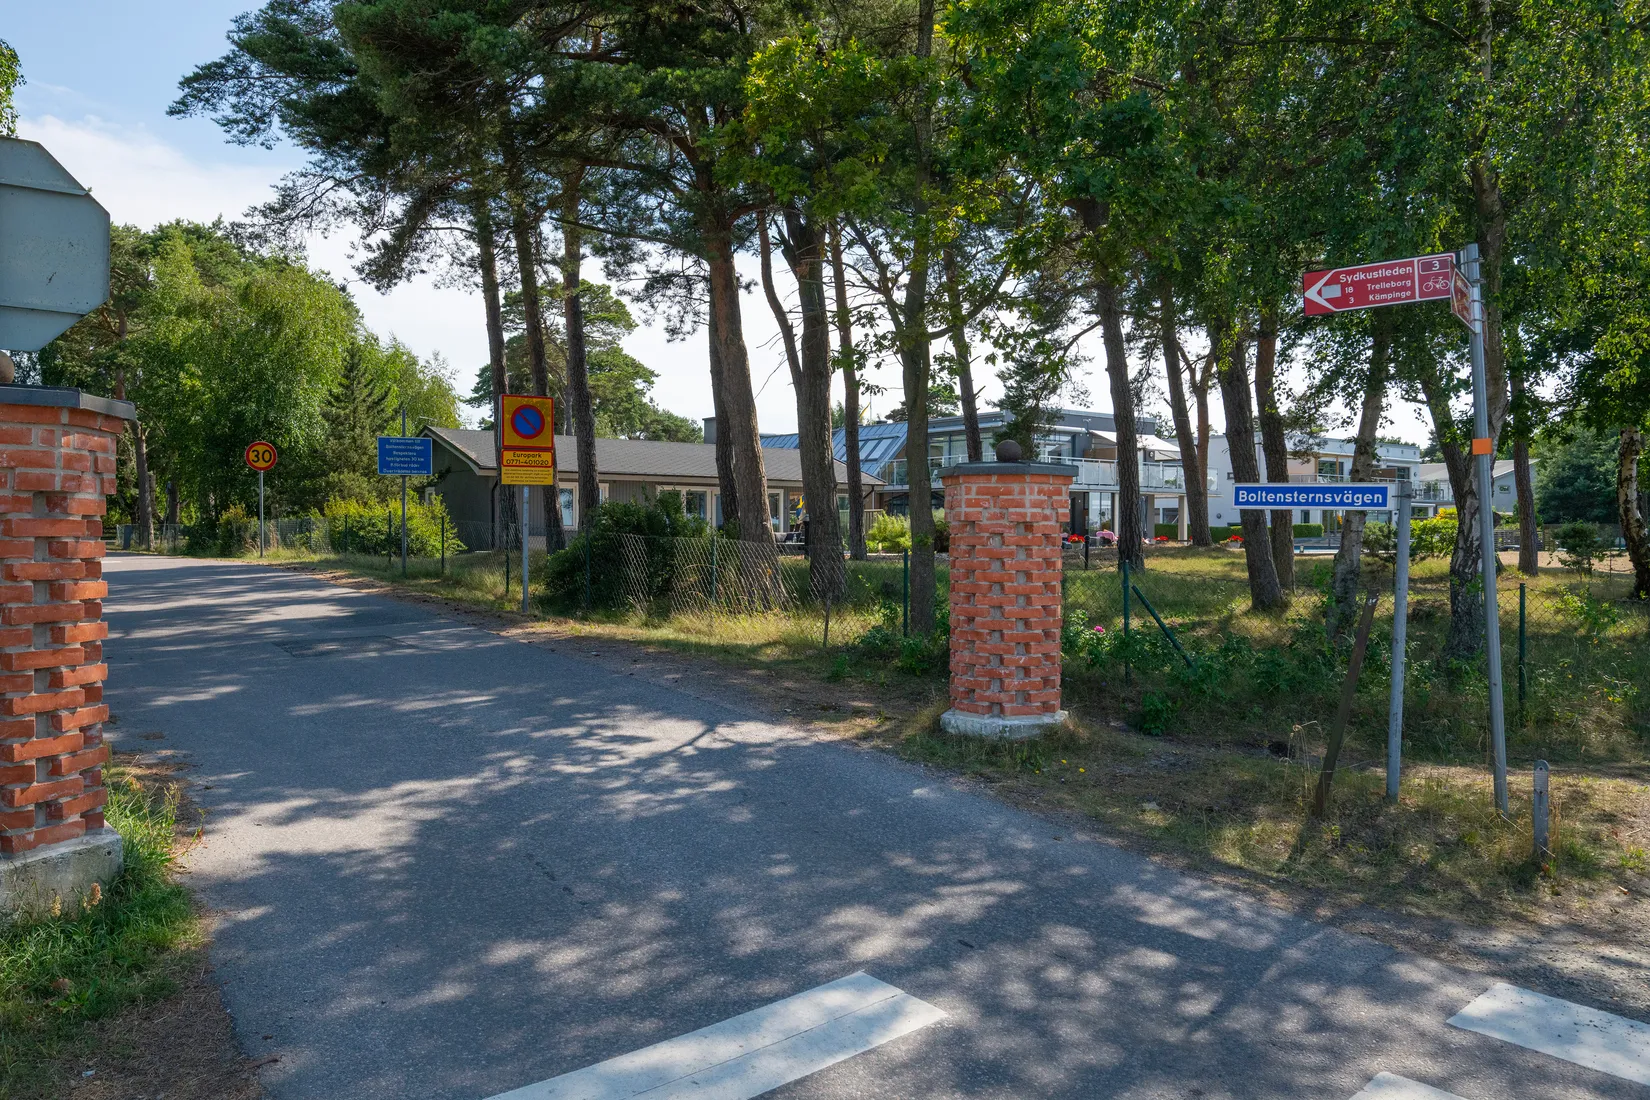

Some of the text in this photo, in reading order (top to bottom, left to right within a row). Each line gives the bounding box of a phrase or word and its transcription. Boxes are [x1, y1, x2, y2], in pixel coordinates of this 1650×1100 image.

[1431, 260, 1440, 271] 3
[1339, 265, 1413, 284] Sydkustleden
[1345, 279, 1412, 294] 18 Trelleborg
[1349, 290, 1412, 304] 3 Kämpinge
[251, 449, 272, 463] 30
[1238, 490, 1383, 506] Boltensternsvägen
